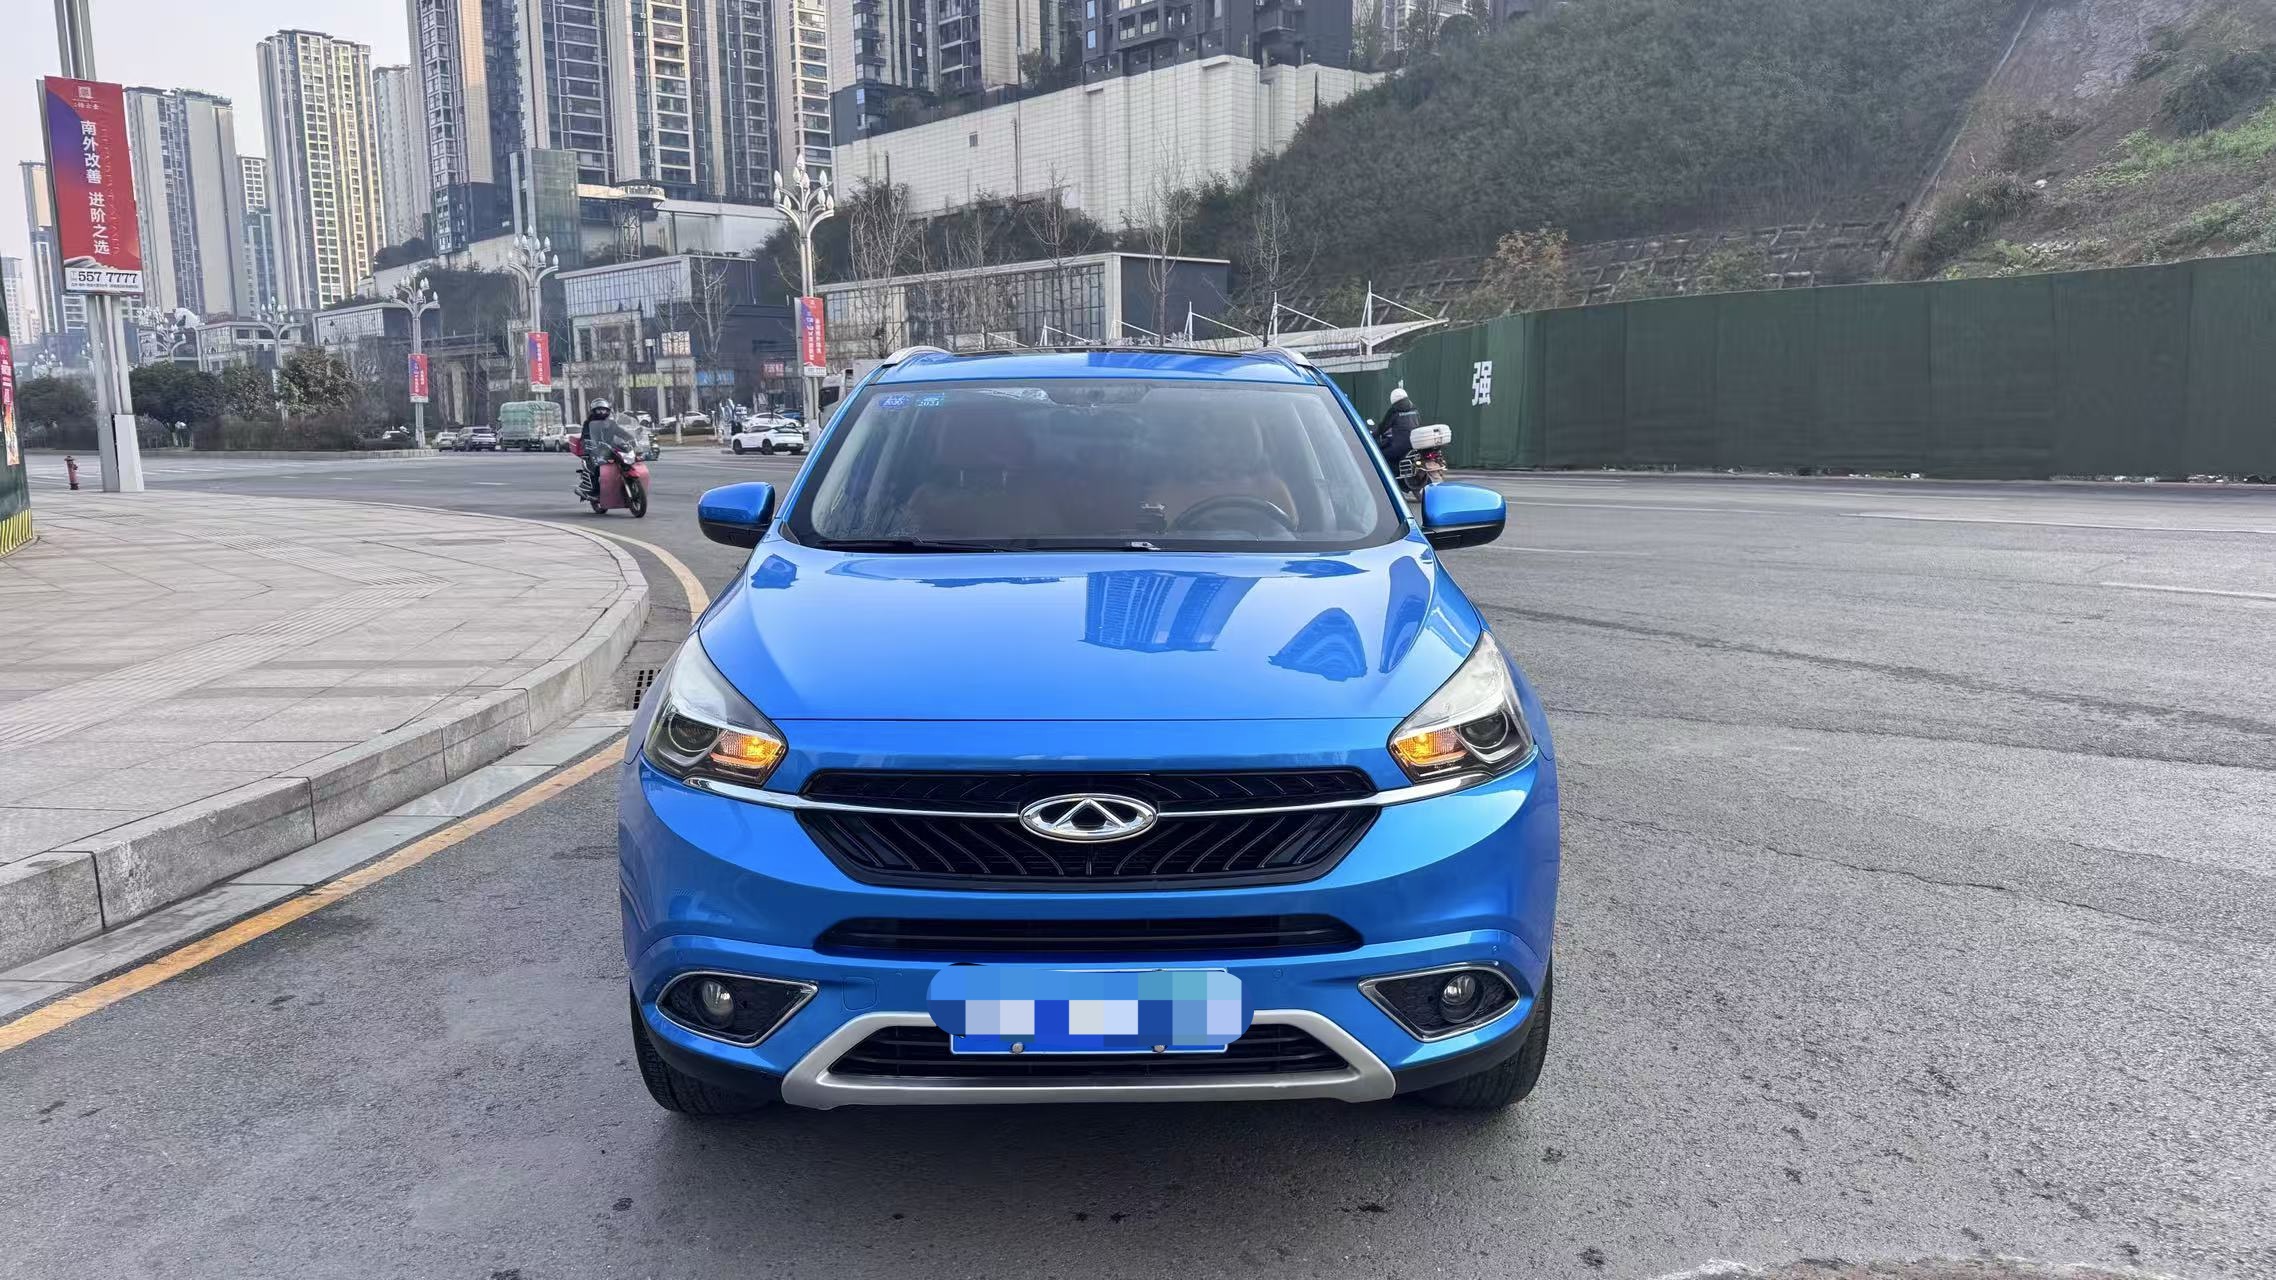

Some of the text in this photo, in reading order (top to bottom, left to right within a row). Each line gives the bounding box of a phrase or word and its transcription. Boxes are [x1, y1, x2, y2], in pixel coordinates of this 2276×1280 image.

[80, 120, 101, 184] 南外改善
[88, 191, 110, 255] 进阶之选
[78, 271, 102, 282] 557
[105, 272, 138, 284] 7777
[1471, 360, 1493, 406] 强
